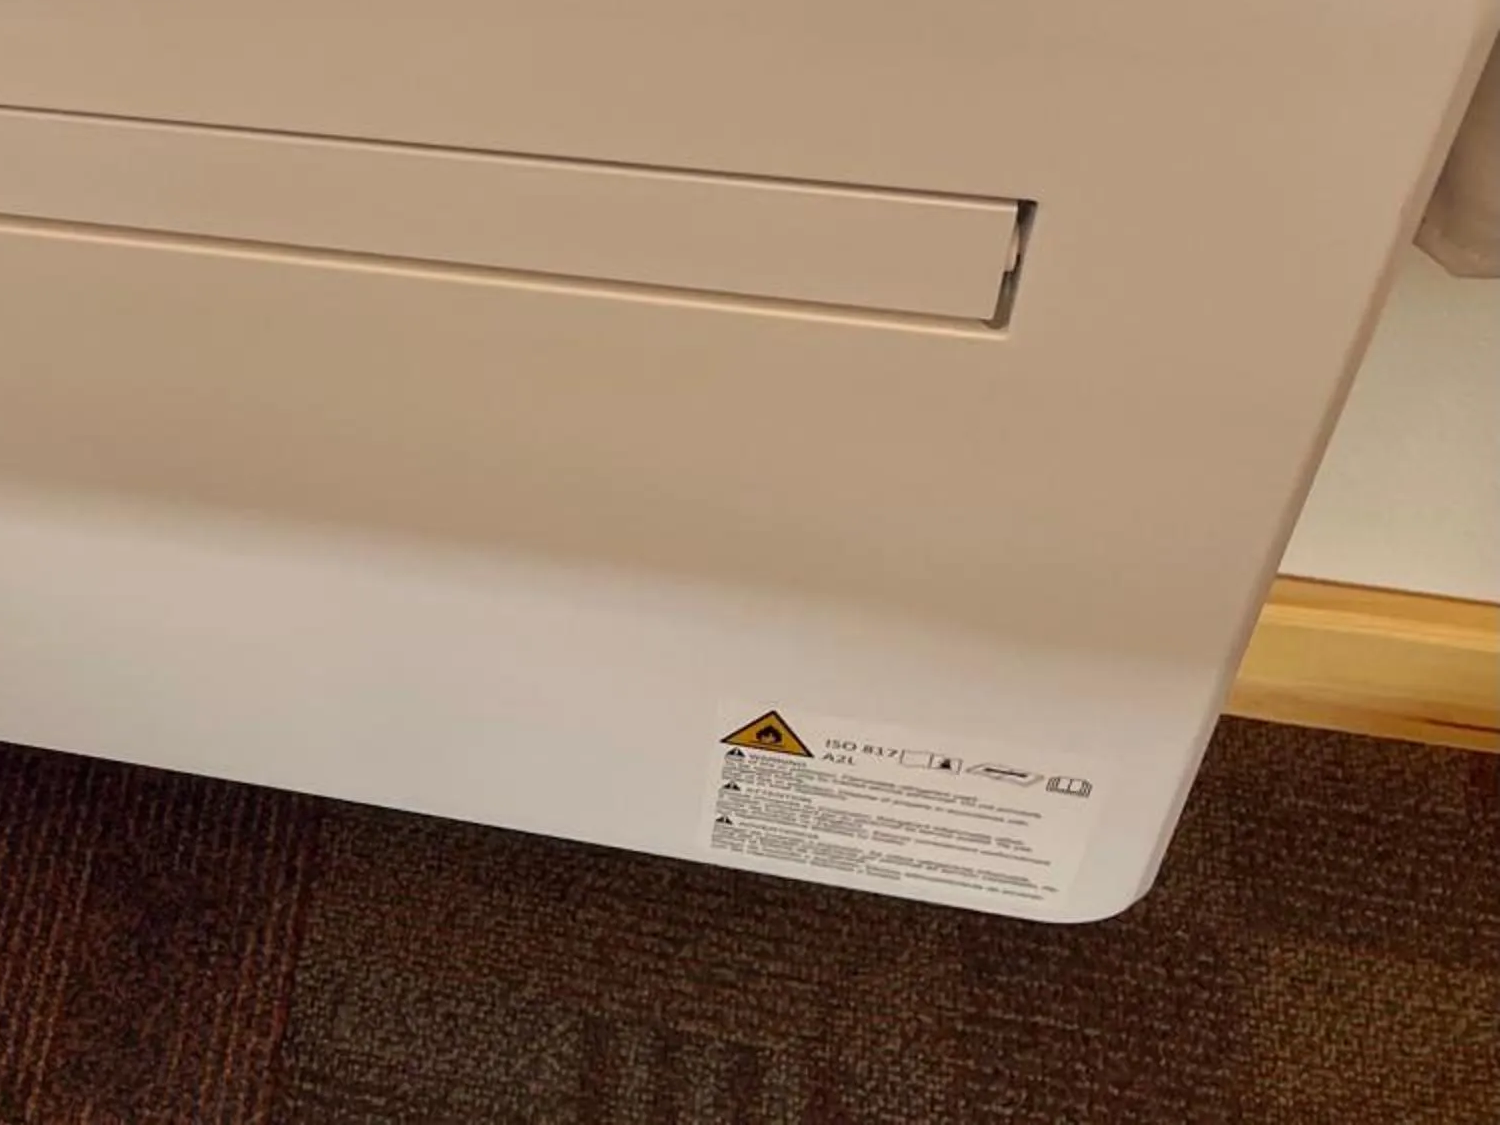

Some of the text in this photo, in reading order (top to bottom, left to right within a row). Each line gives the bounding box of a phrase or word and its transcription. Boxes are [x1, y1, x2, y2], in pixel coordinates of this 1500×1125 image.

[825, 739, 898, 758] ISO 817
[822, 753, 855, 766] A2L
